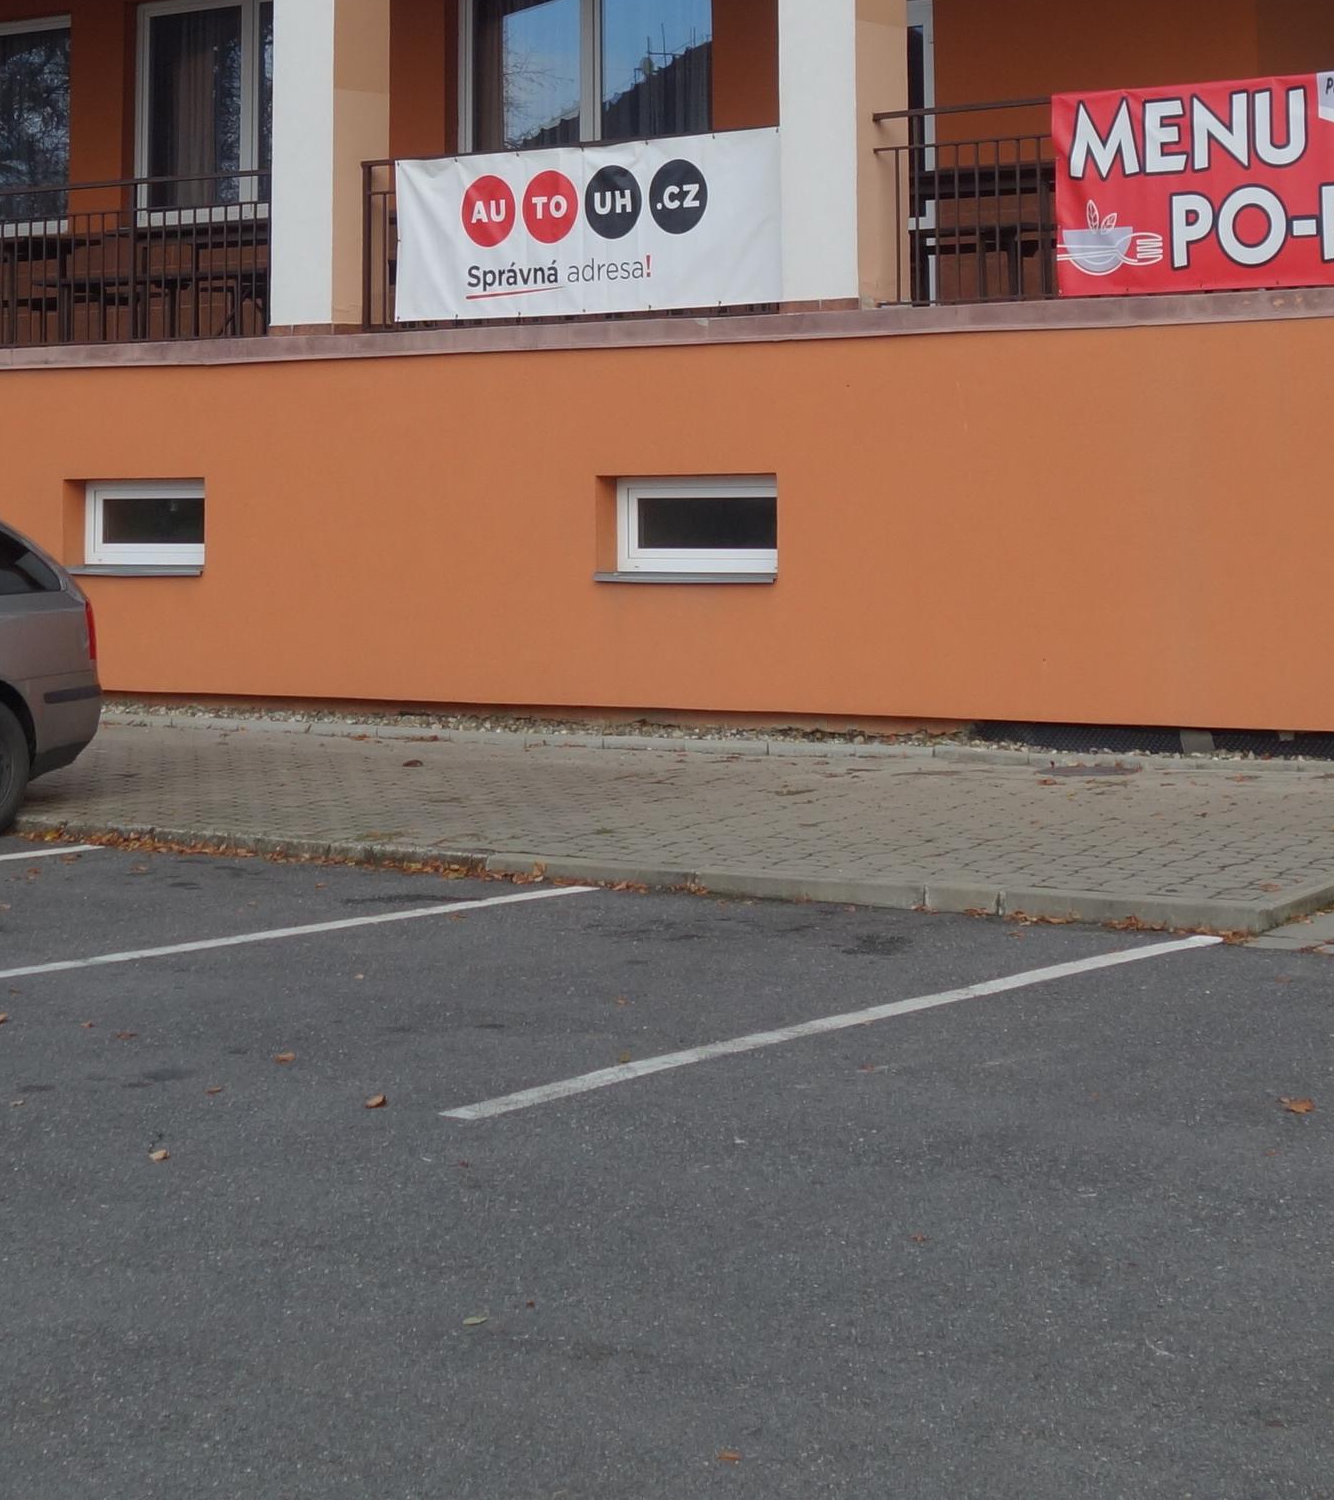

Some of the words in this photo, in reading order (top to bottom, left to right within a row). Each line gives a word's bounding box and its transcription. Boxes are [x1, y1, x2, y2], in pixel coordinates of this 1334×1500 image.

[1068, 86, 1307, 180] MENU
[467, 260, 559, 292] Správná
[567, 255, 652, 283] adresa!
